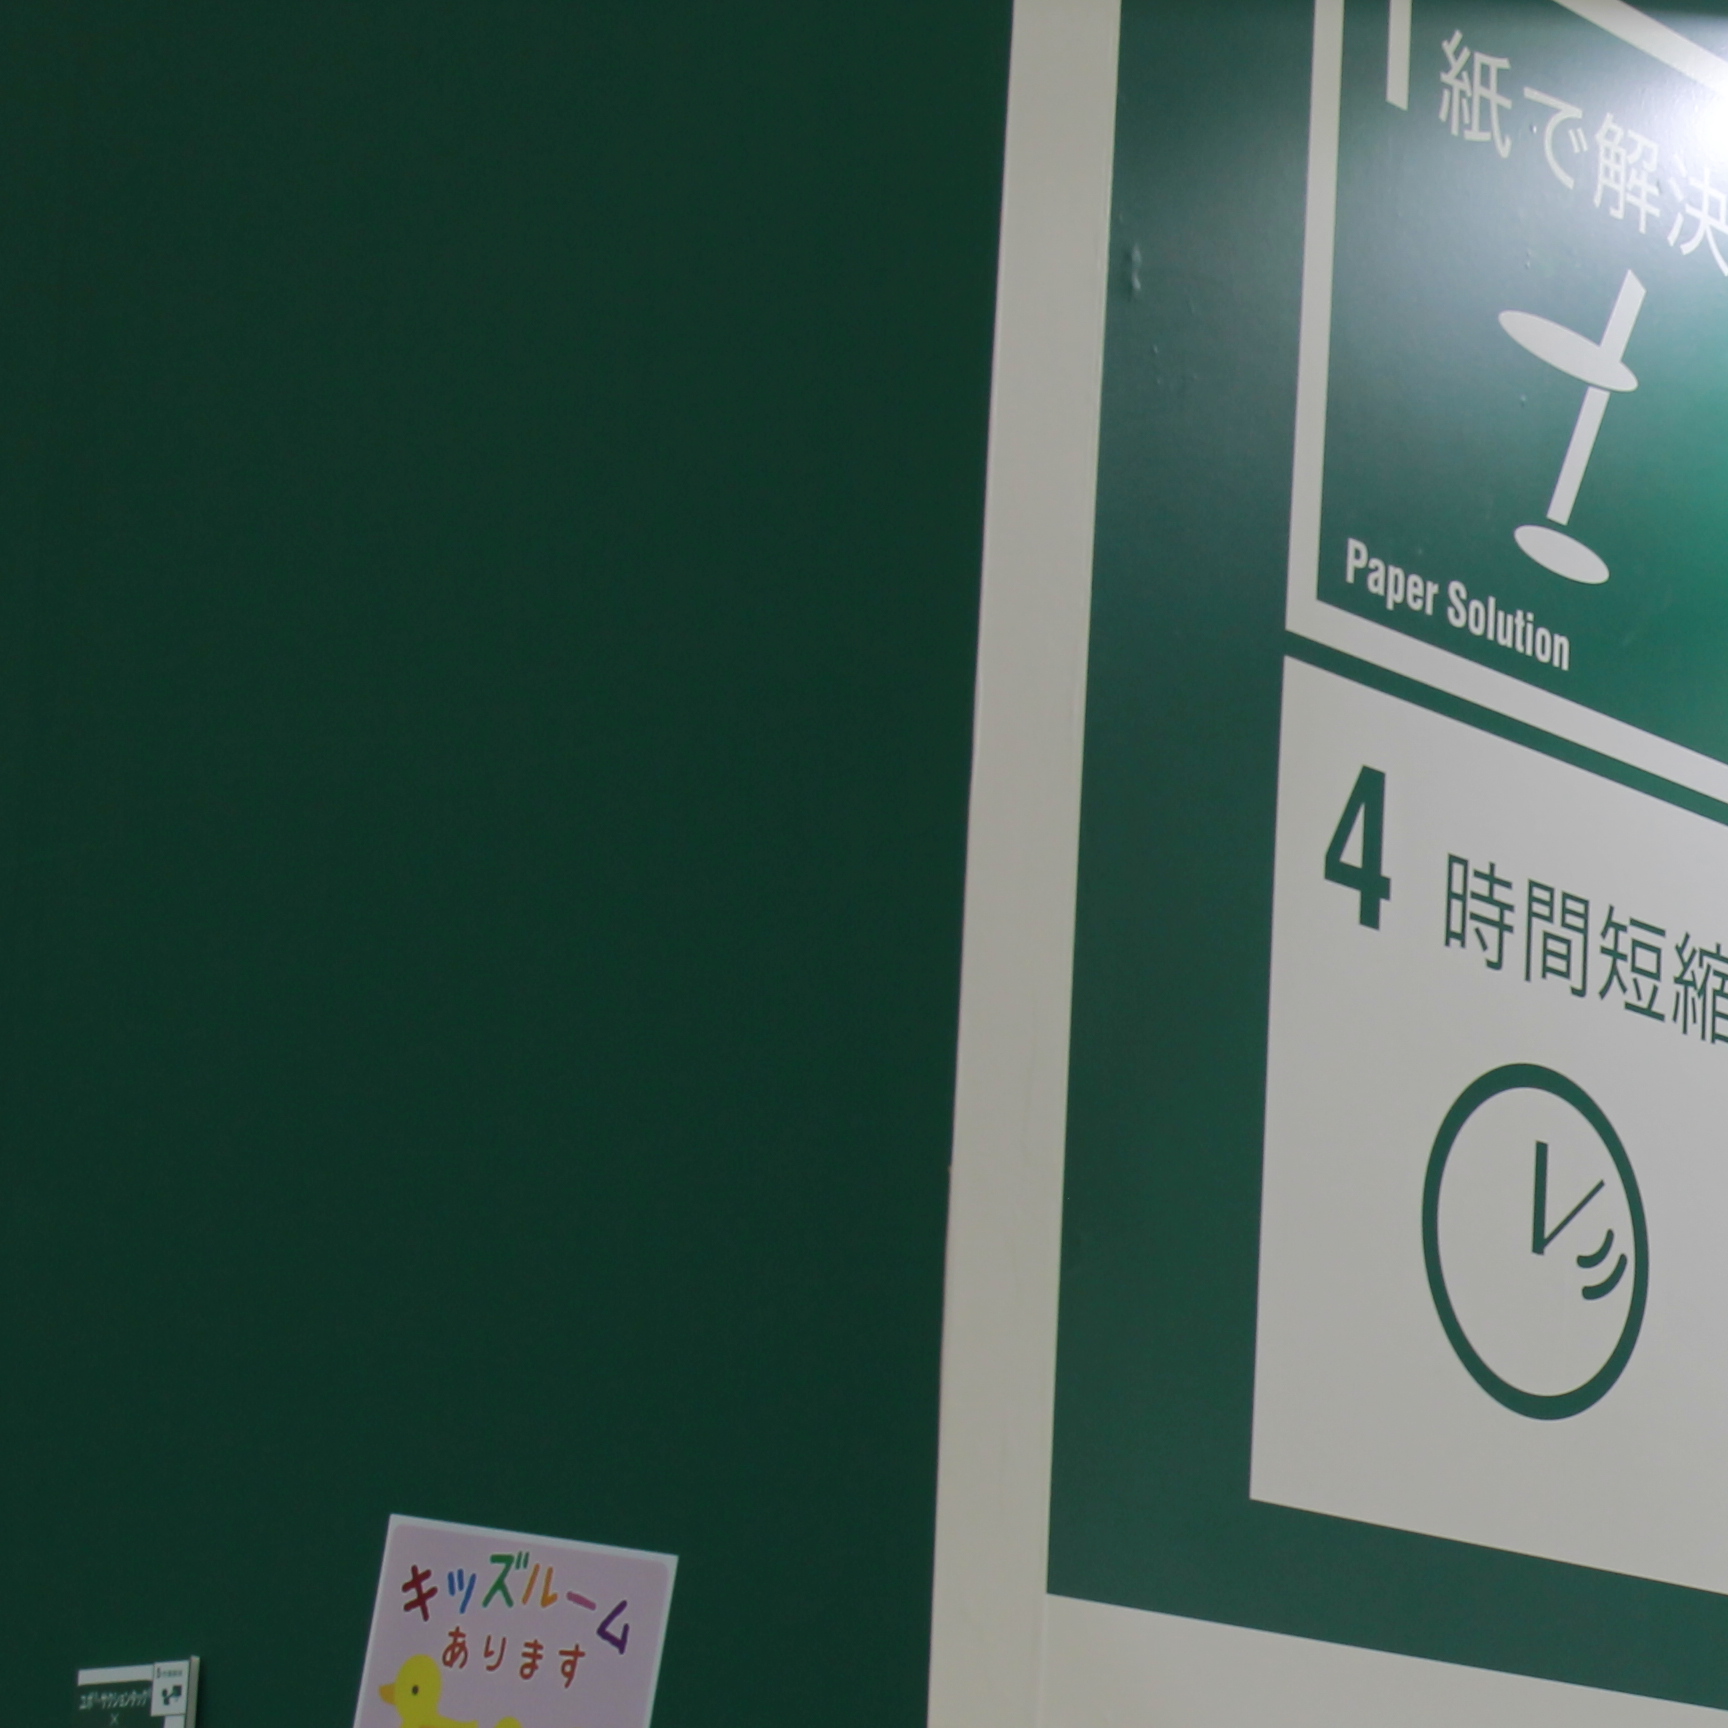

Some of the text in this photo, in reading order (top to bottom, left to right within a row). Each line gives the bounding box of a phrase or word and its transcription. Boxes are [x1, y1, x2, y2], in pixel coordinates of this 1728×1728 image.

[1345, 538, 1572, 672] Paper Solution
[1324, 765, 1391, 931] 4
[402, 1551, 630, 1655] キッズルーム
[442, 1626, 586, 1689] あります
